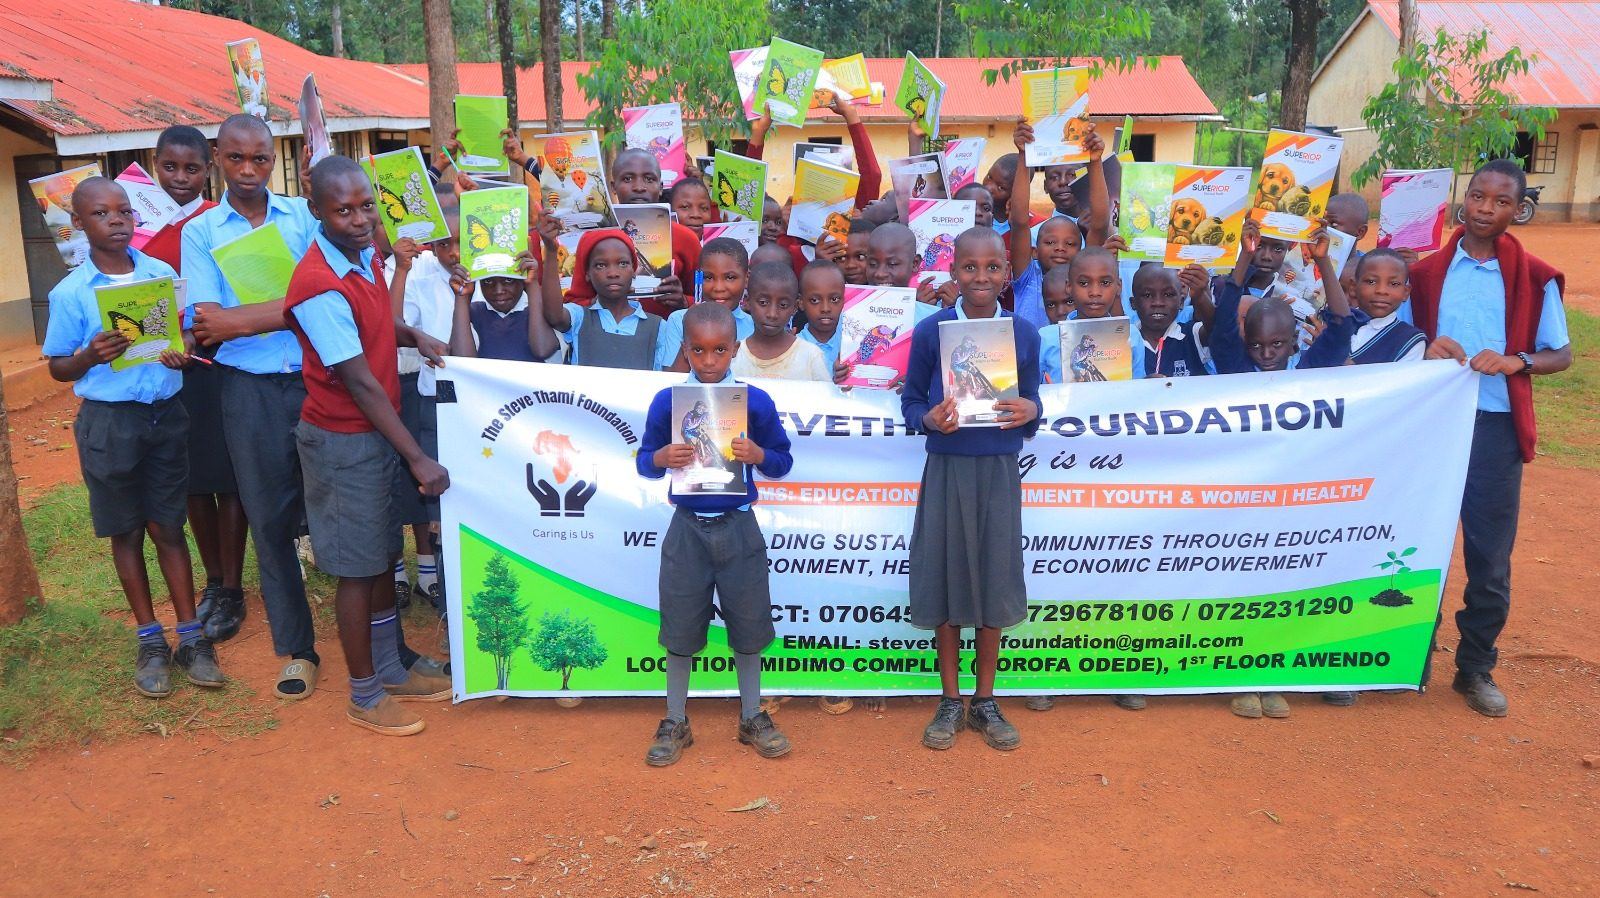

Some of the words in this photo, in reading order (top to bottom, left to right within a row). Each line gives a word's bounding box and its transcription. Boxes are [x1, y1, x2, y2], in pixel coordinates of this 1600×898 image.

[646, 121, 674, 129] SUPERIOR
[1284, 149, 1321, 161] SUPERIOR
[1192, 184, 1230, 193] SUPERIOR
[136, 191, 167, 218] SUPERIOR
[931, 216, 965, 224] SUPERIOR
[869, 306, 904, 316] SUPERIOR
[481, 418, 504, 442] The
[498, 395, 534, 421] Steve
[533, 390, 575, 406] Thami
[577, 394, 638, 445] Foundation
[1050, 450, 1077, 470] is
[1089, 453, 1124, 470] us
[801, 487, 919, 502] EDUCATION
[1102, 489, 1173, 504] YOUTH
[1180, 490, 1194, 504] &
[1201, 490, 1276, 504] WOMEN
[1292, 483, 1364, 502] HEALTH
[532, 528, 567, 541] Caring
[569, 529, 578, 539] is
[580, 530, 594, 539] Us
[623, 531, 658, 547] WE
[1022, 535, 1154, 551] OMMUNITIES
[1162, 532, 1269, 550] THROUGH
[1274, 524, 1396, 548] EDUCATION,
[767, 558, 873, 577] ONMENT,
[1031, 557, 1151, 574] ECONOMIC
[1156, 552, 1328, 572] EMPOWERMENT
[819, 605, 911, 623] 070645
[1028, 604, 1174, 622] 729678106
[1198, 596, 1354, 621] 0725231290
[783, 634, 861, 650] EMAIL:
[760, 657, 845, 673] MIDIMO
[852, 657, 963, 673] COMPL
[970, 657, 1071, 676] (OROFA
[1079, 656, 1169, 675] ODEDE),
[1177, 656, 1207, 671] 1ST
[1212, 654, 1286, 670] FLOOR
[1292, 651, 1391, 668] AWENDO
